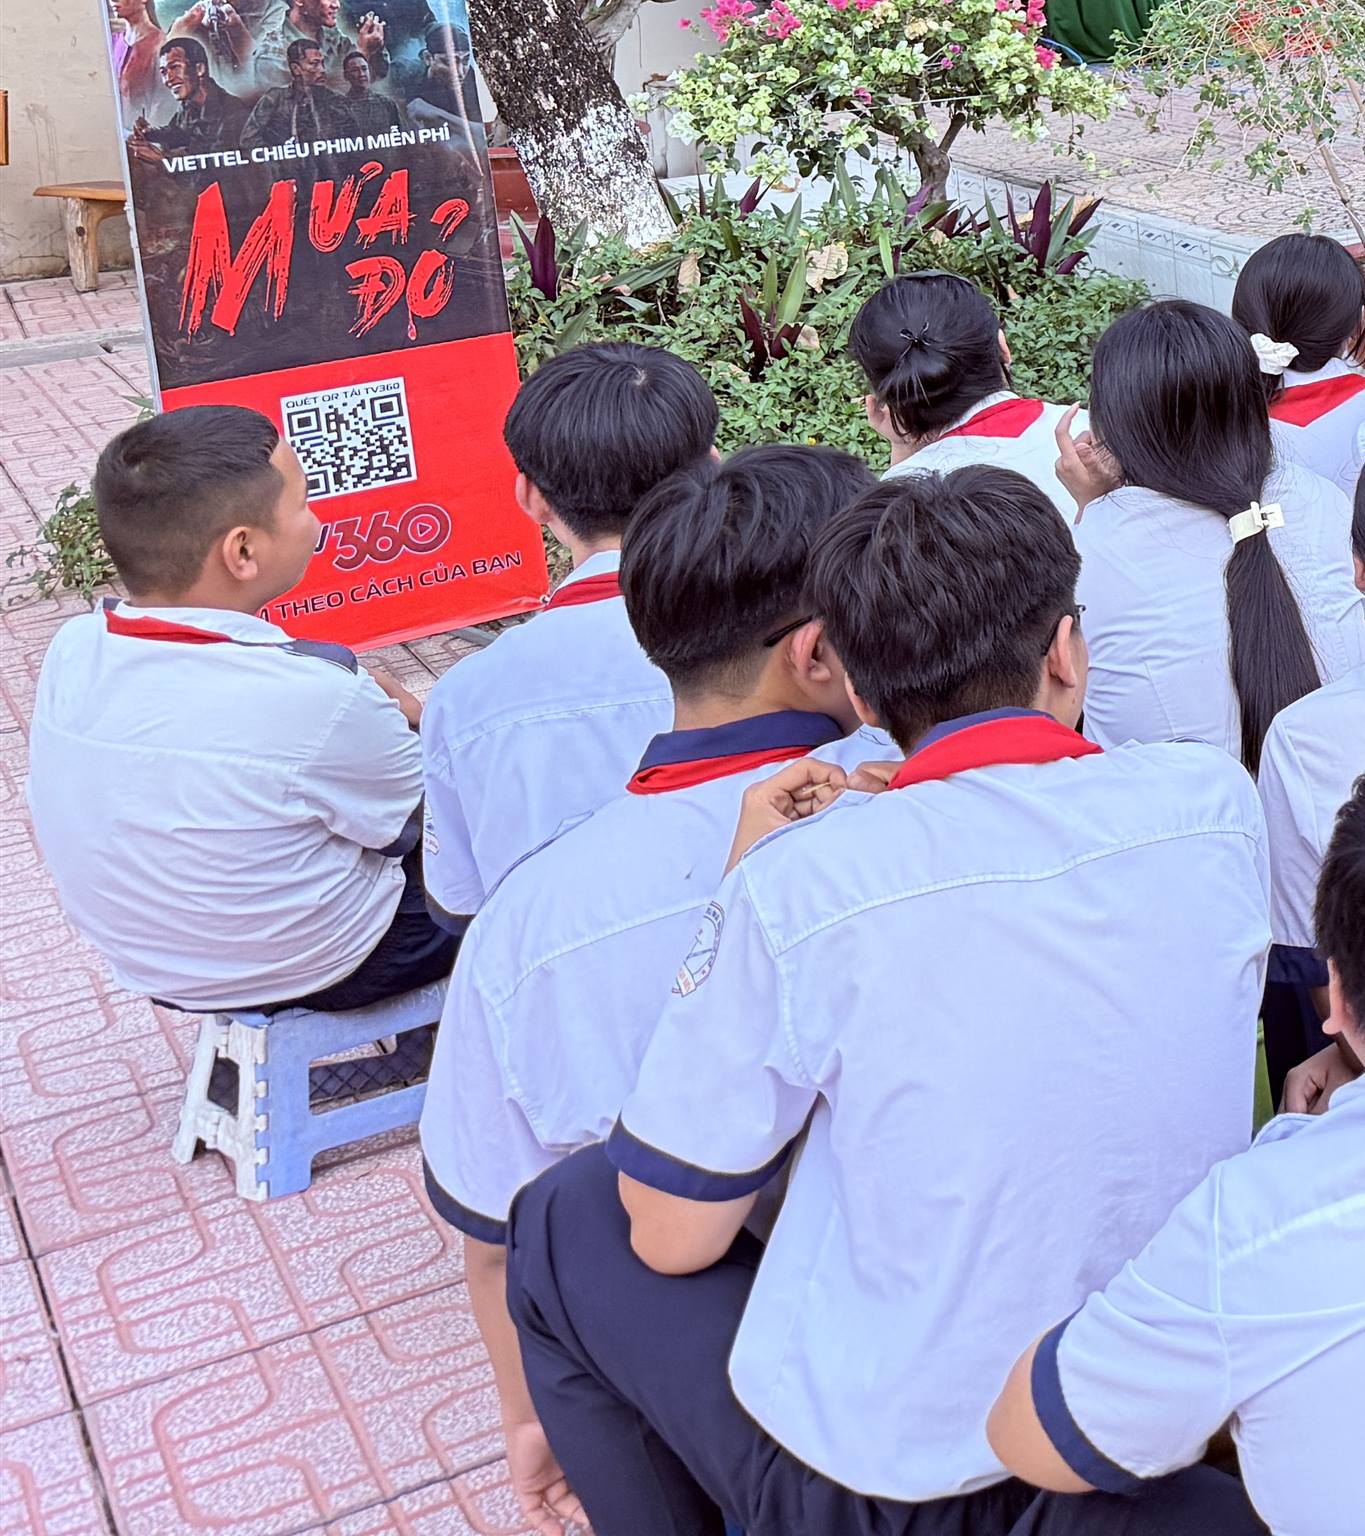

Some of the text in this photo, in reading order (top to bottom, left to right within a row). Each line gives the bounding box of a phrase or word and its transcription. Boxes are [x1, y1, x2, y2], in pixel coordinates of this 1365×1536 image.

[162, 122, 450, 174] VIETTEL CHIẾU PHIM MIỄN PHÍ
[179, 161, 418, 344] MƯA
[285, 395, 318, 409] QUÉT
[321, 393, 339, 403] QR
[365, 381, 400, 395] TV360
[313, 503, 452, 572] V360
[276, 590, 345, 620] THEO
[350, 578, 414, 603] CÁCH
[419, 561, 467, 587] CỦA
[472, 550, 523, 577] BẠN
